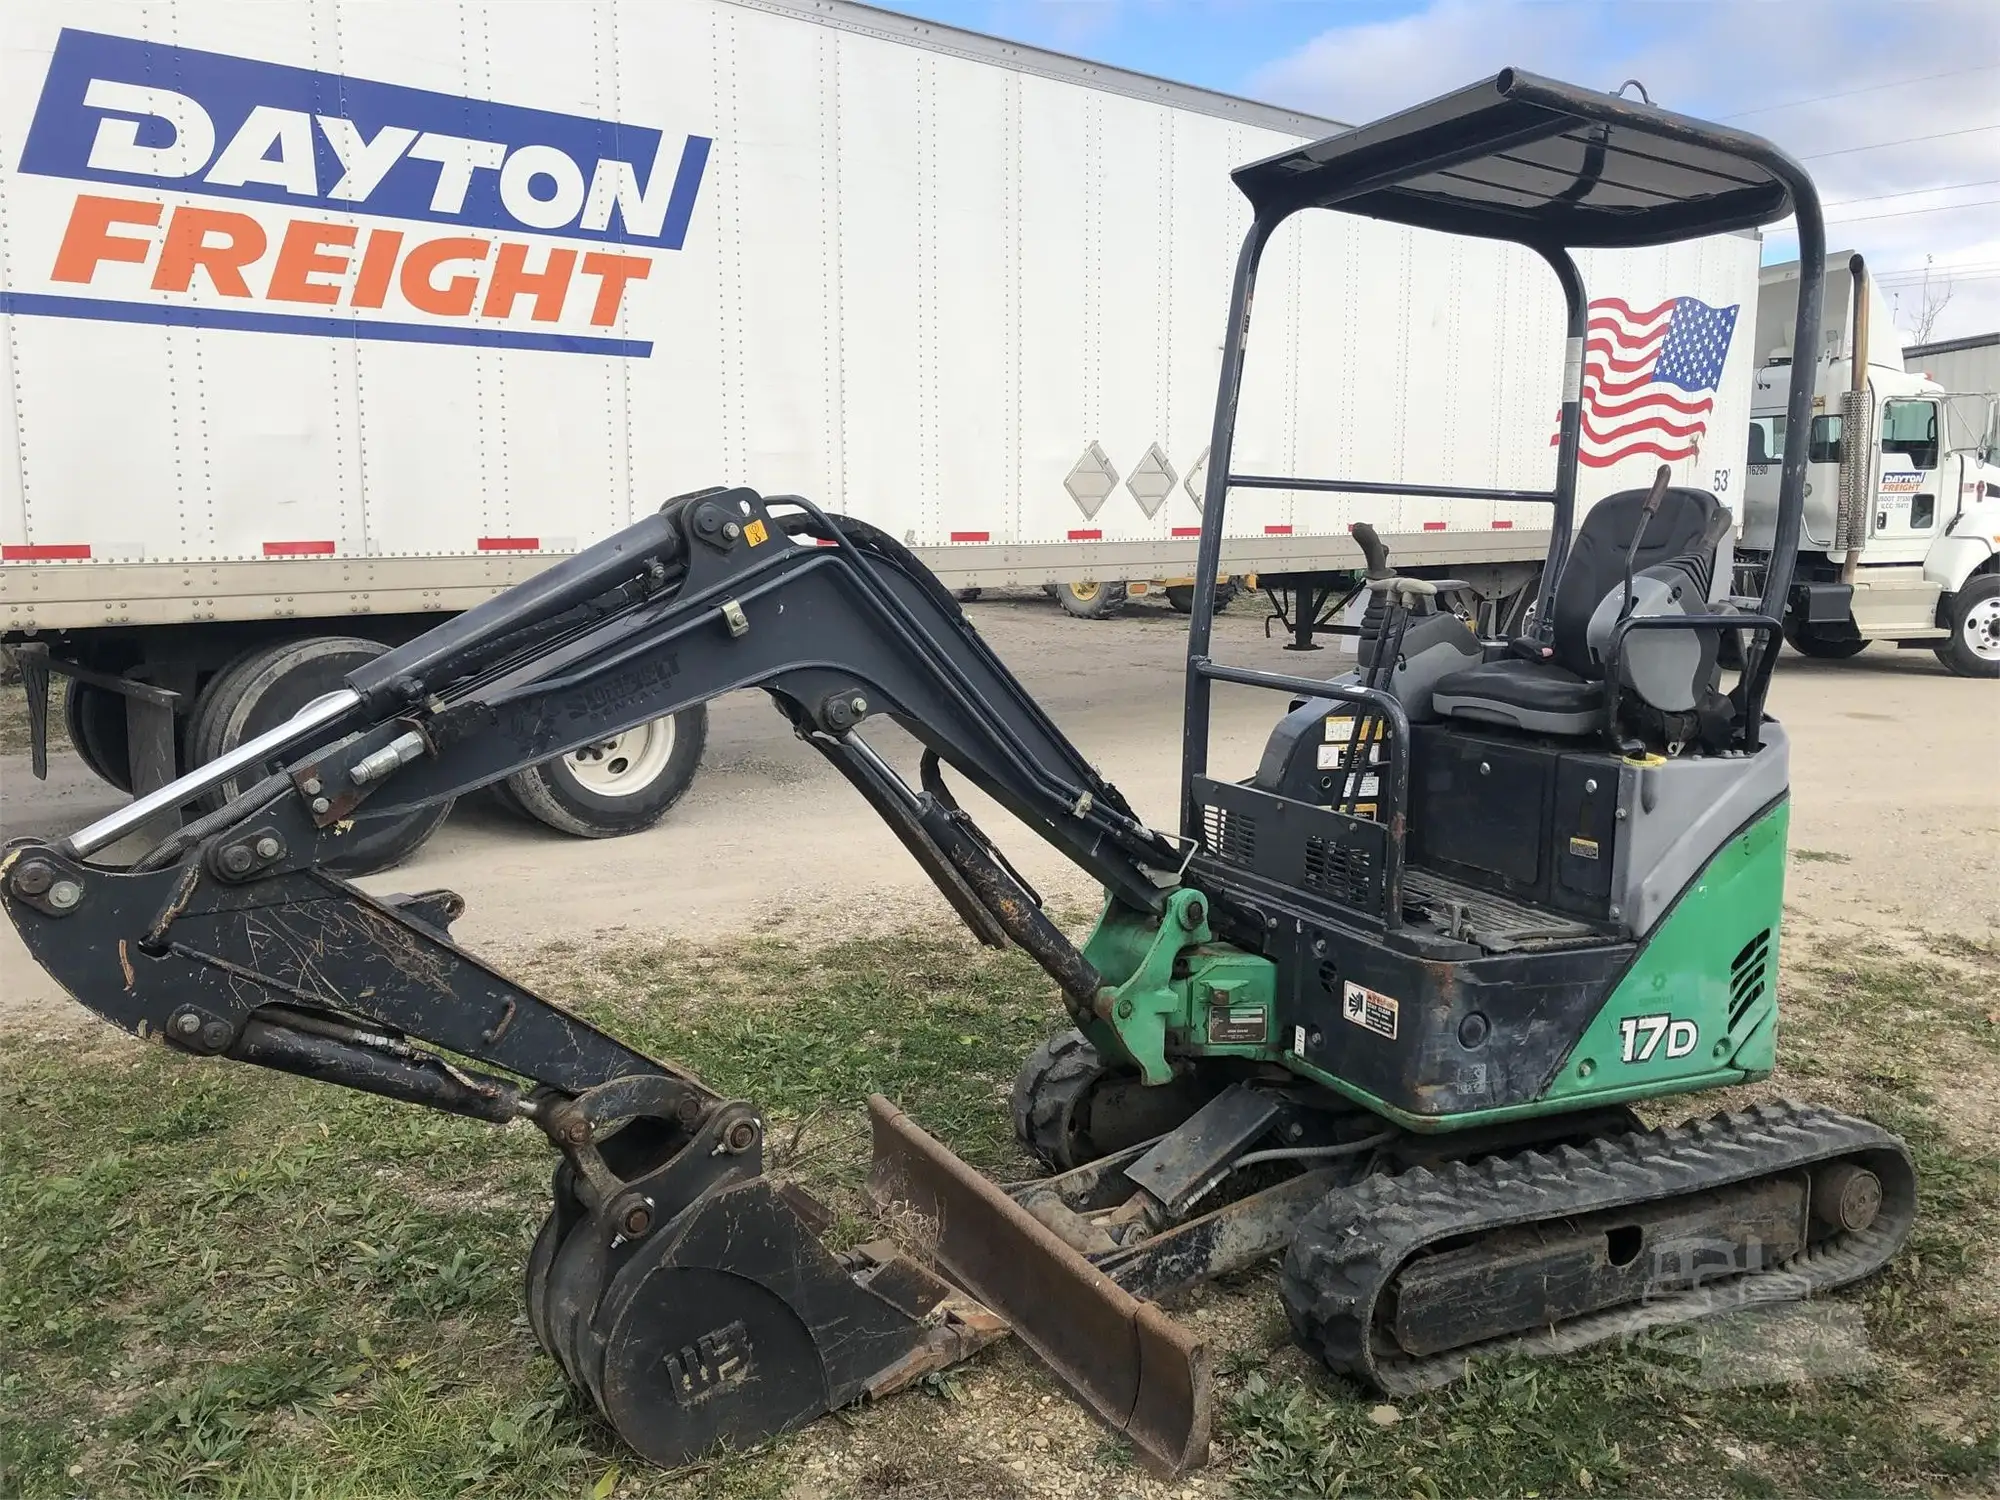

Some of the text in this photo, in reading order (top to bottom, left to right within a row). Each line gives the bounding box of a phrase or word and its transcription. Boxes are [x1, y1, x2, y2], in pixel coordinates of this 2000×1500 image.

[82, 78, 680, 238] DAYTON
[50, 194, 653, 327] FREIGHT
[1884, 474, 1922, 483] DAYTON
[1620, 1013, 1699, 1064] 17D
